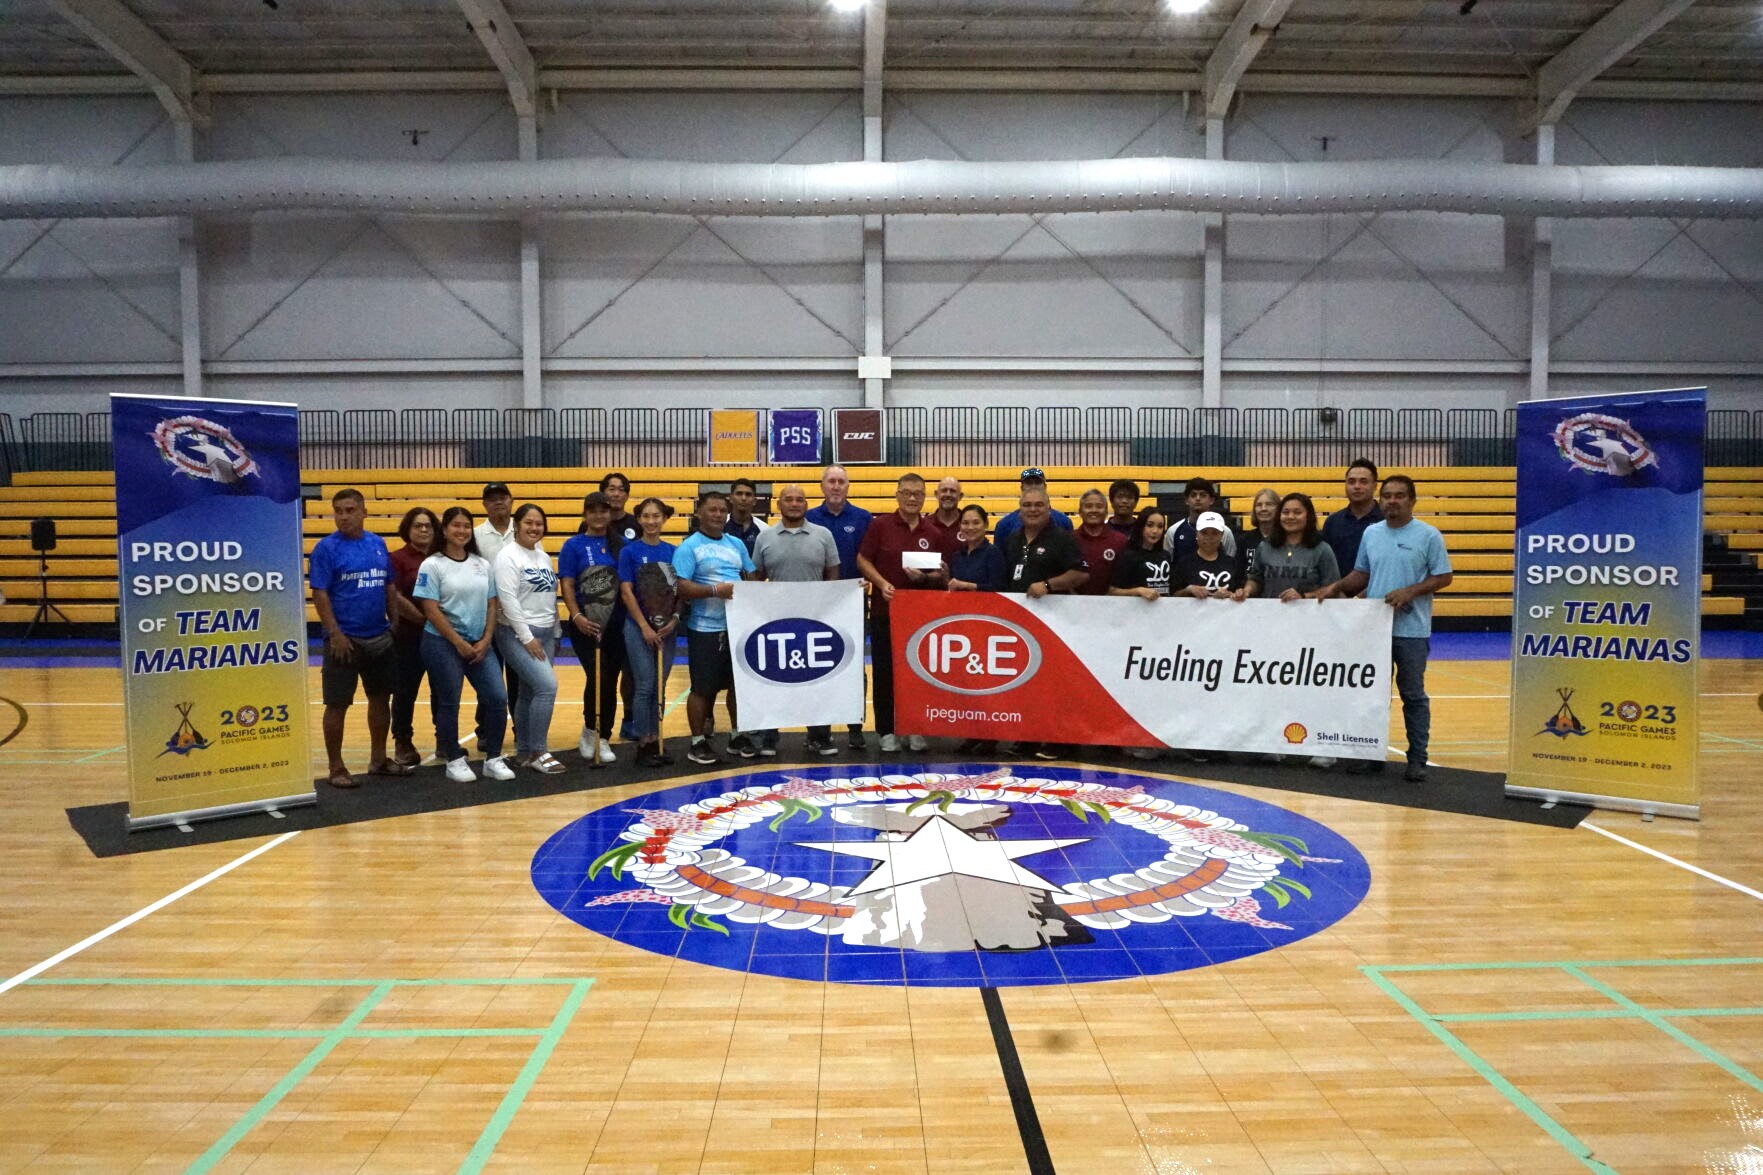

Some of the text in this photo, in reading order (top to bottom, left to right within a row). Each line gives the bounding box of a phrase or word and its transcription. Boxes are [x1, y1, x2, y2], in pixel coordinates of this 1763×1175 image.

[780, 427, 811, 445] PSS
[843, 432, 875, 440] CUC
[131, 541, 243, 562] PROUD
[1528, 533, 1636, 554] PROUD
[132, 571, 285, 596] SPONSOR
[1526, 565, 1680, 586] SPONSOR
[138, 607, 262, 636] OF TEAM
[1529, 600, 1652, 626] OF TEAM
[132, 638, 300, 676] MARIANAS
[757, 631, 835, 671] IT&E
[928, 632, 1018, 676] IP&E
[1521, 633, 1692, 664] MARIANAS
[1124, 644, 1376, 691] Fueling Excellence
[220, 704, 289, 728] 2023
[926, 704, 1022, 723] ipeguam.com
[1600, 700, 1677, 724] 2023
[220, 724, 290, 739] PACIFIC GAMES
[220, 732, 290, 745] SOLOMON ISLANDS
[1316, 732, 1379, 744] Shell Licensee
[1599, 722, 1677, 736] PACIFIC GAMES
[1599, 730, 1677, 741] SOLOMON ISLANDS
[1532, 752, 1576, 762] NOVEMBER
[1594, 758, 1639, 768] DECEMBER
[1650, 763, 1672, 771] 2023
[155, 771, 201, 783] NOVEMBER
[219, 764, 261, 775] DECEMBER
